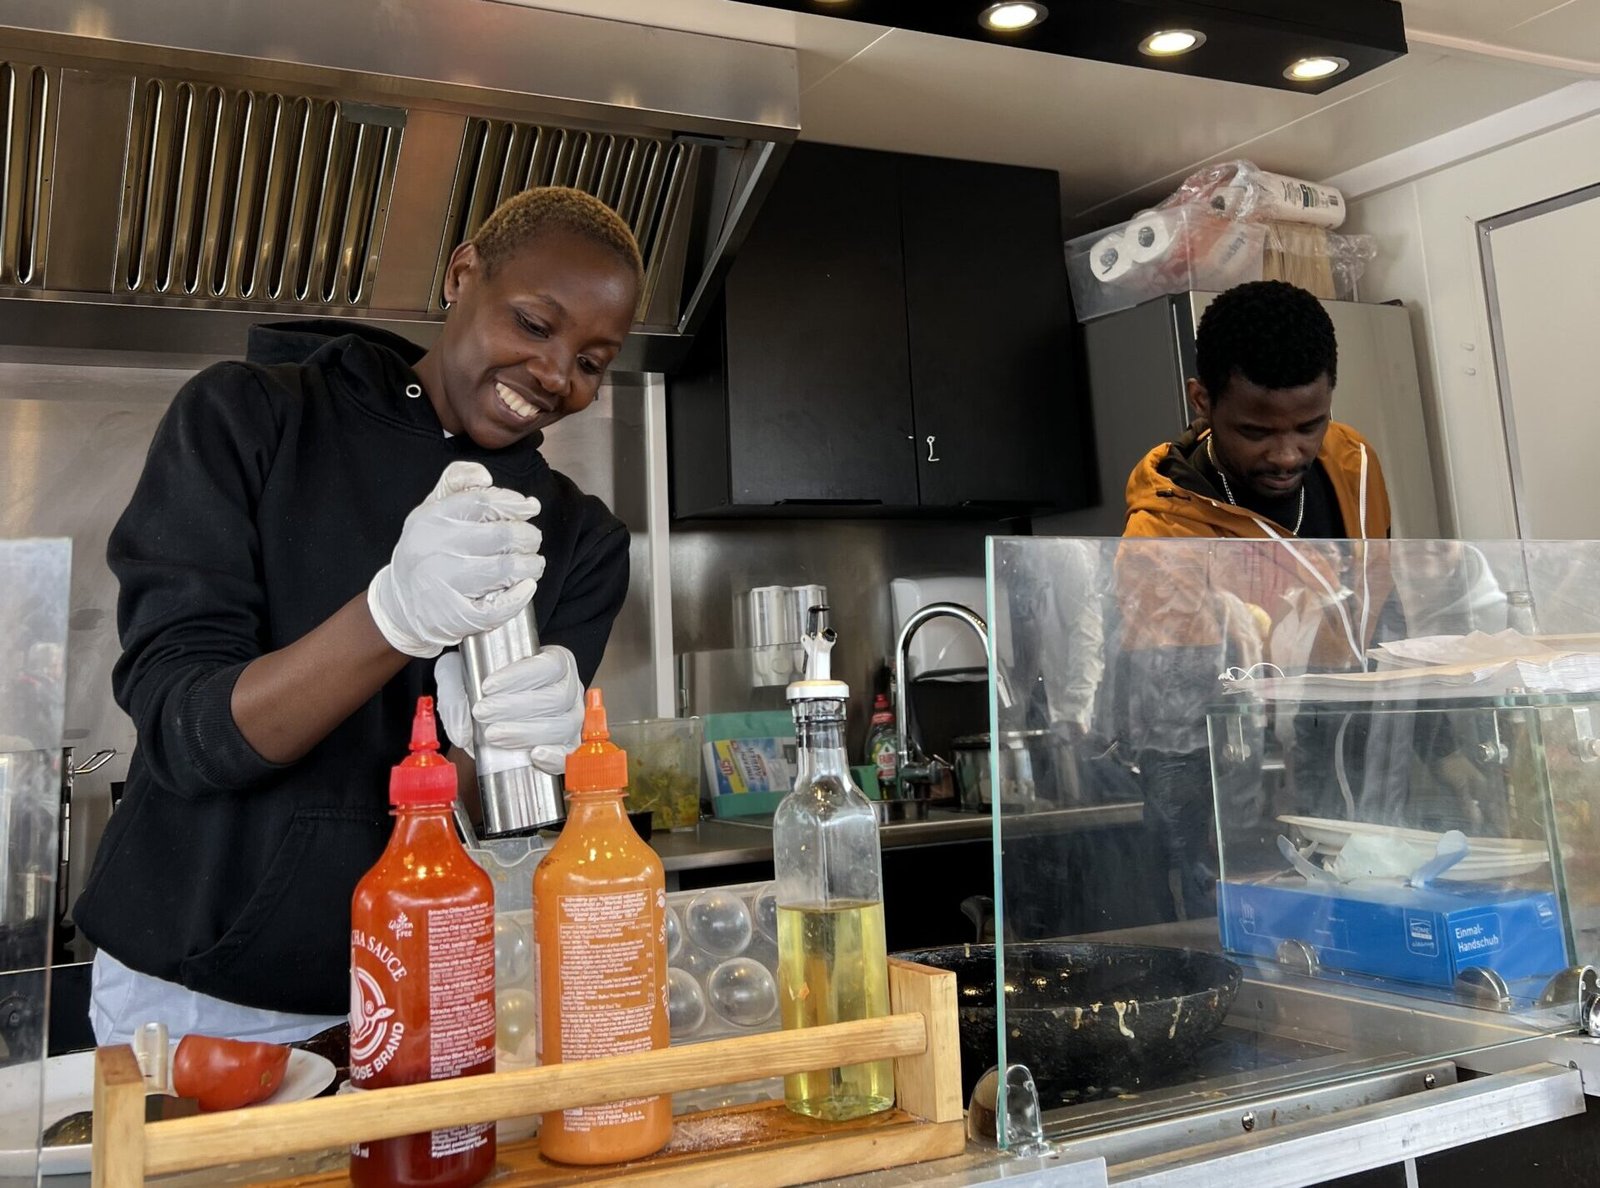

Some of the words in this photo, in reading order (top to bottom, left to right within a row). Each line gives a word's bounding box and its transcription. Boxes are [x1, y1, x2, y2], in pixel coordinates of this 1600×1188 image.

[388, 918, 414, 931] Gluten
[1455, 923, 1484, 940] Einmal-
[396, 928, 413, 941] Free
[1457, 934, 1499, 953] Handschuh
[367, 935, 408, 982] SAUCE
[372, 1021, 405, 1073] BRAND
